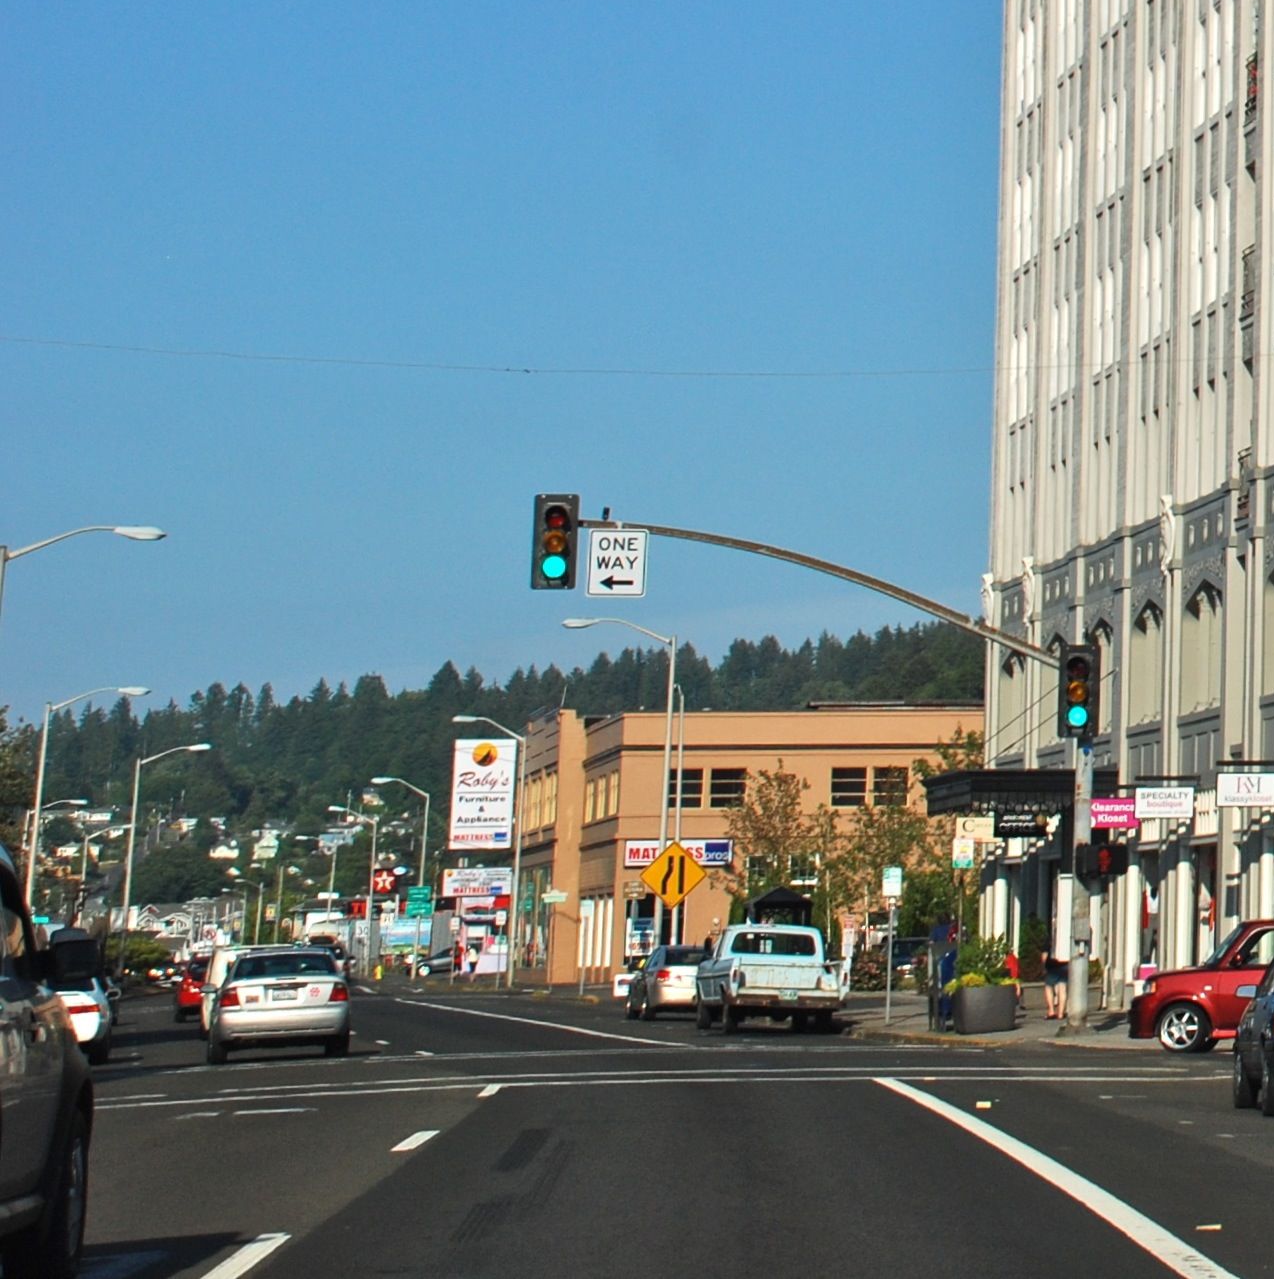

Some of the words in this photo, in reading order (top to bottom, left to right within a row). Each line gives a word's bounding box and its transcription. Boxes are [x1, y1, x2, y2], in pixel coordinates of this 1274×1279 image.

[598, 537, 639, 551] ONE
[596, 556, 639, 570] WAY
[457, 771, 510, 790] Roby's
[459, 795, 506, 803] Furniture
[1140, 792, 1190, 800] SPECIALTY
[1146, 801, 1183, 809] boutique
[457, 816, 507, 825] Appliance
[1097, 814, 1128, 823] Kloset
[628, 847, 703, 860] MATSS
